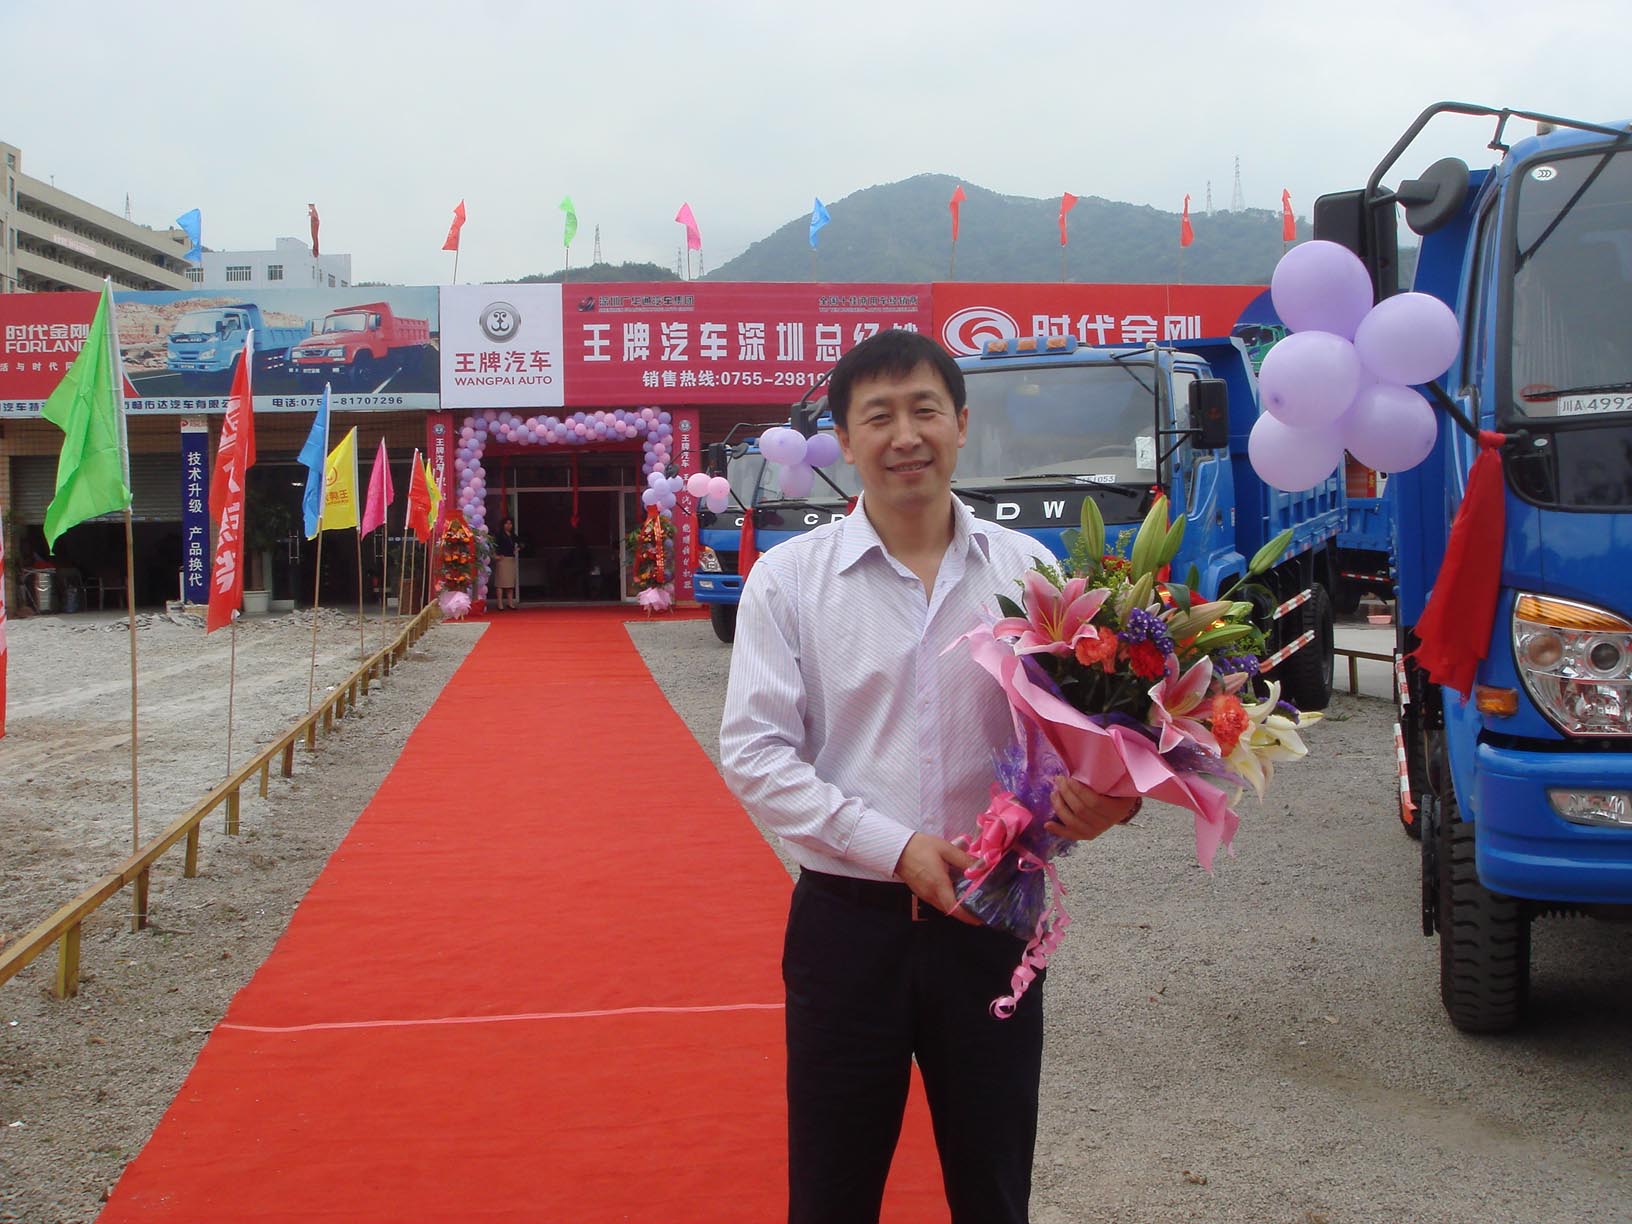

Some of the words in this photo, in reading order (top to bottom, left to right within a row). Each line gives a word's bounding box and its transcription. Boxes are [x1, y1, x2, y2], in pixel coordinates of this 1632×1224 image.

[455, 350, 552, 373] 王牌汽车
[455, 376, 515, 386] WANGPAI
[518, 375, 553, 385] AUTO
[188, 451, 203, 514] 技术升级
[188, 526, 203, 587] 产品换代
